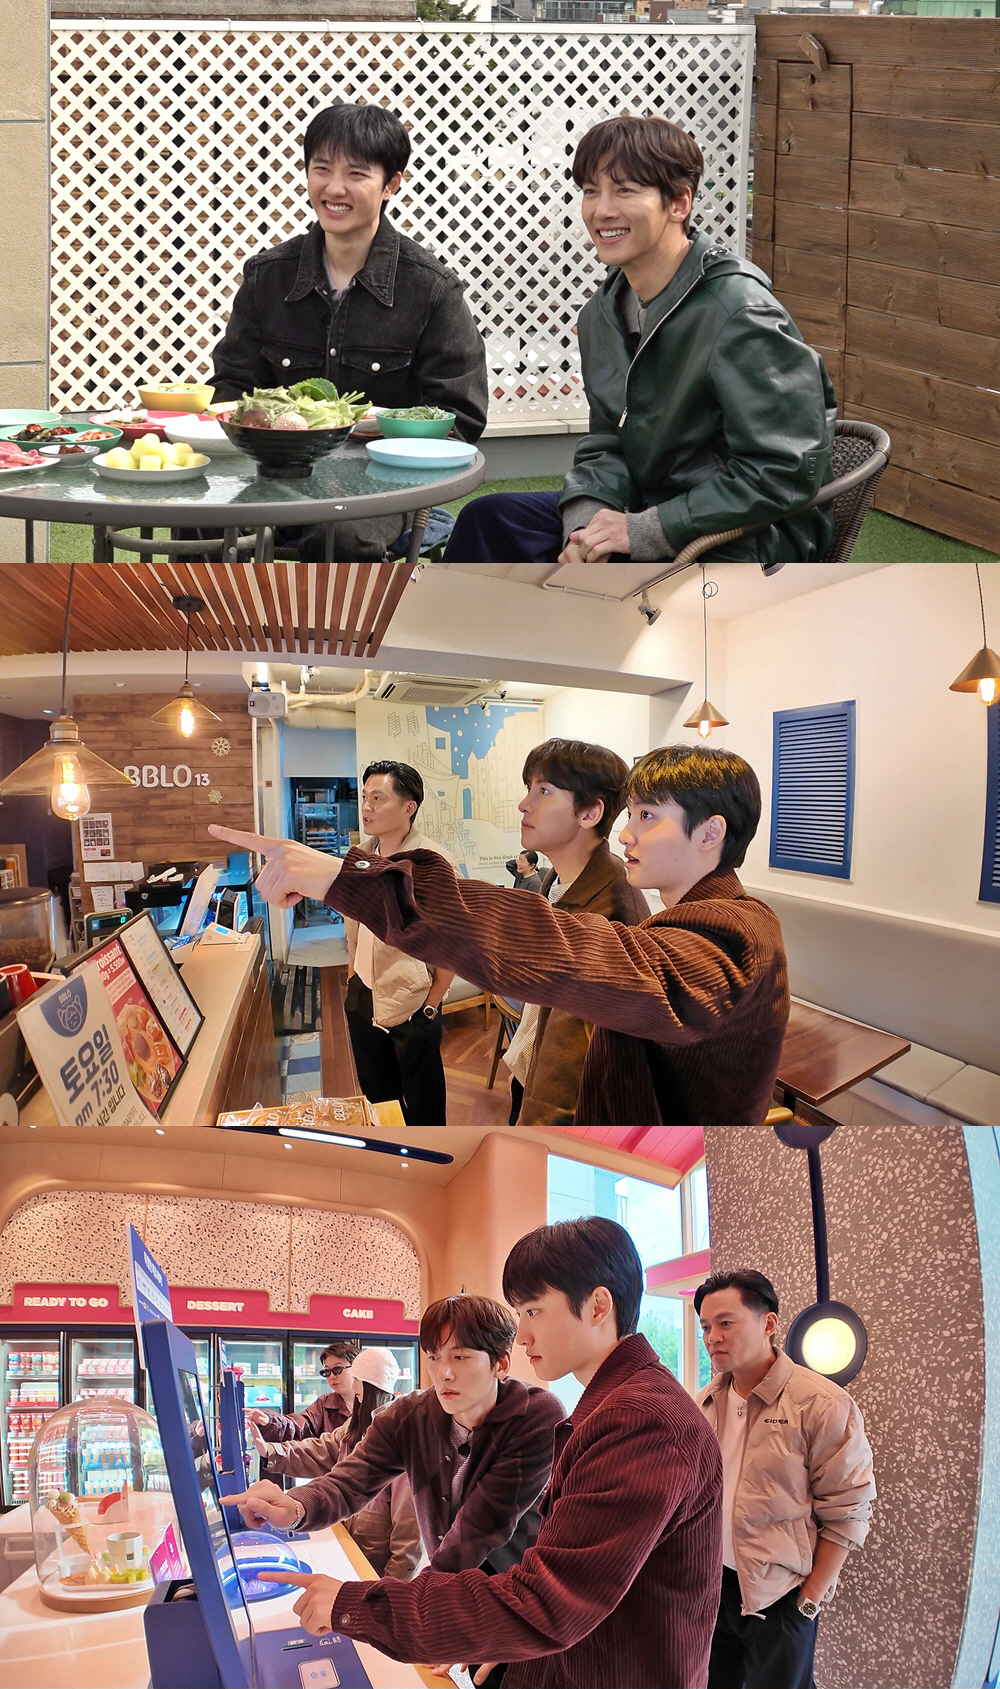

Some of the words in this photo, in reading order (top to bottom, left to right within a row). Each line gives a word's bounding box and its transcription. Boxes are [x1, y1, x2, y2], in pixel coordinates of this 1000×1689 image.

[194, 774, 210, 786] 13
[96, 944, 122, 971] roissant
[60, 1024, 114, 1104] 토요일
[91, 1060, 119, 1107] 7:30
[108, 1084, 126, 1113] 입니다
[24, 1296, 66, 1308] READY
[69, 1298, 86, 1307] TO
[88, 1298, 108, 1308] GO
[187, 1300, 244, 1312] DESSERT
[342, 1308, 374, 1320] CAKE
